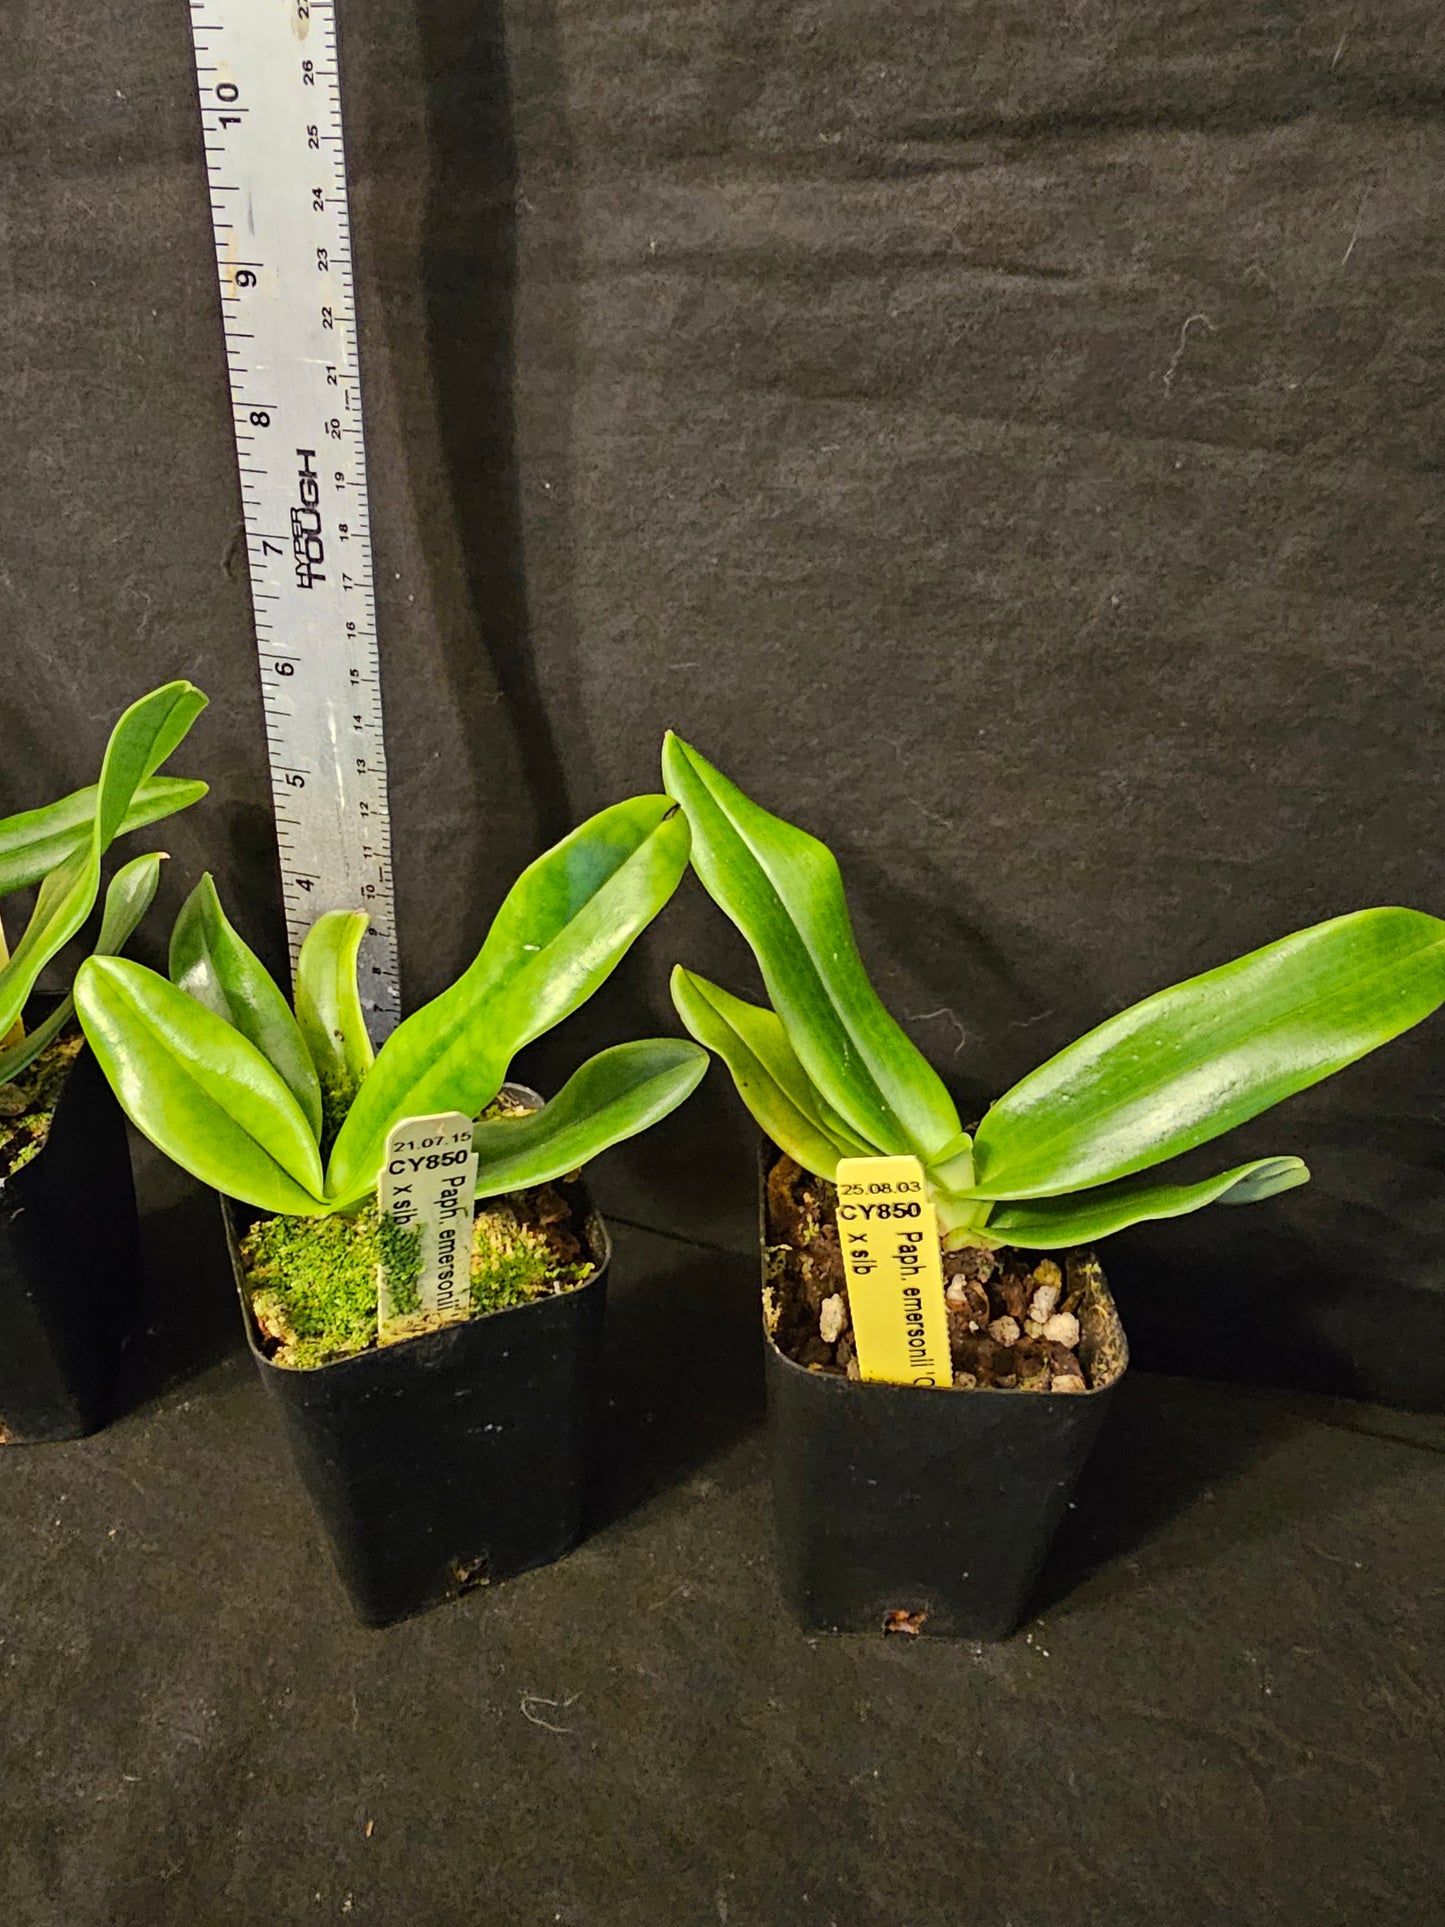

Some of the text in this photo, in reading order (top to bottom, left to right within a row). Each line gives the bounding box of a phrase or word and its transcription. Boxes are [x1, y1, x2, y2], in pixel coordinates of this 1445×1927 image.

[303, 59, 314, 86] 26
[216, 82, 242, 130] 10
[308, 124, 320, 150] 25
[313, 187, 324, 212] 24
[318, 248, 329, 272] 23
[235, 269, 257, 288] 9
[322, 306, 333, 329] 22
[327, 365, 337, 386] 21
[250, 411, 271, 428] 8
[331, 418, 341, 440] 20
[334, 472, 345, 491] 19
[296, 448, 326, 581] TOUGH
[339, 523, 349, 542] 18
[262, 540, 283, 556] 7
[343, 573, 353, 591] 17
[347, 621, 356, 640] 16
[275, 662, 295, 677] 6
[350, 669, 360, 686] 15
[353, 715, 363, 731] 14
[357, 758, 366, 775] 13
[286, 774, 305, 789] 5
[360, 801, 369, 818] 12
[363, 845, 372, 859] 11
[295, 878, 314, 892] 4
[366, 884, 376, 900] 10
[393, 1130, 472, 1153] 21.07.15
[388, 1149, 468, 1176] CY850
[840, 1180, 922, 1196] 25.08.03
[393, 1199, 417, 1226] sib
[839, 1201, 922, 1222] CY850
[433, 1175, 466, 1311] Paph. emersonii
[851, 1249, 878, 1275] sib
[892, 1231, 927, 1281] Paph.
[902, 1287, 935, 1367] emersonii
